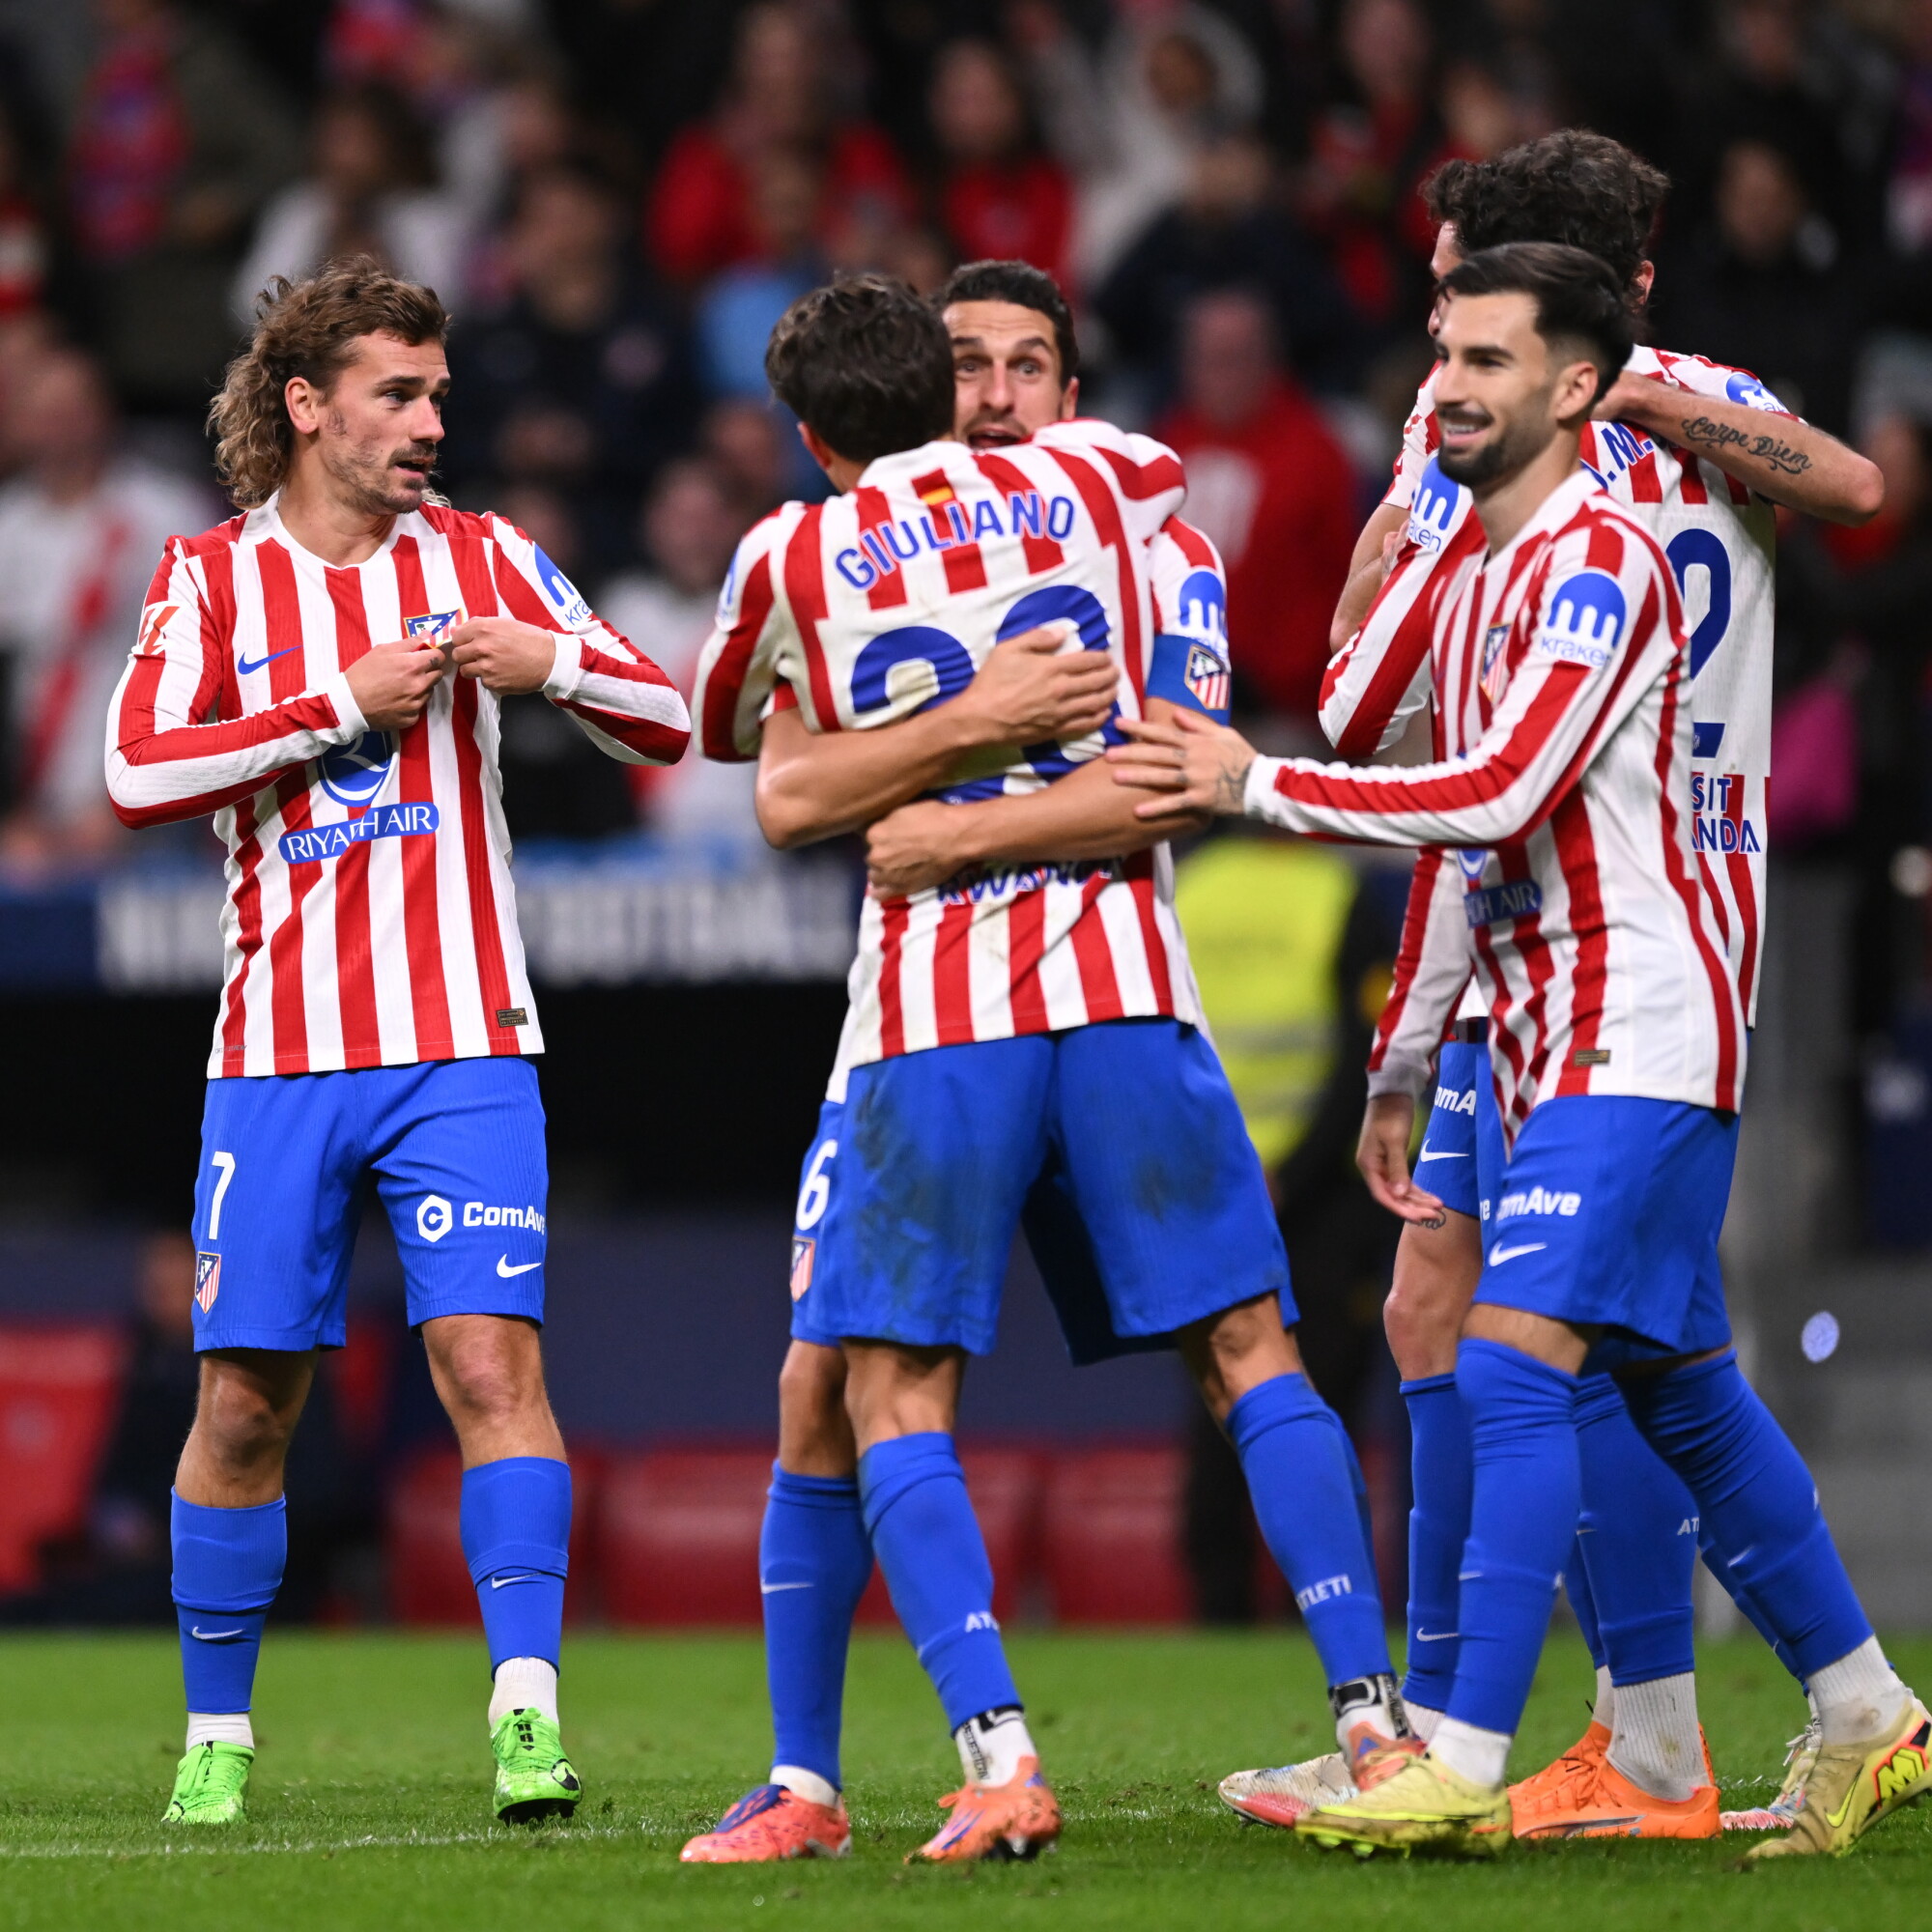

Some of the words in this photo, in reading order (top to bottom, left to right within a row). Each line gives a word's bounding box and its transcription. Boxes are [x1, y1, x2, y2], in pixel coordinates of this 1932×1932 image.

[1747, 436, 1813, 474] Diem
[835, 491, 1074, 590] GIULIANO
[564, 599, 590, 626] kra
[1542, 637, 1610, 667] krake
[1692, 776, 1732, 811] SIT
[384, 806, 433, 833] AIR
[1692, 817, 1762, 854] NDA
[208, 1150, 236, 1240] 7
[795, 1138, 838, 1232] 6
